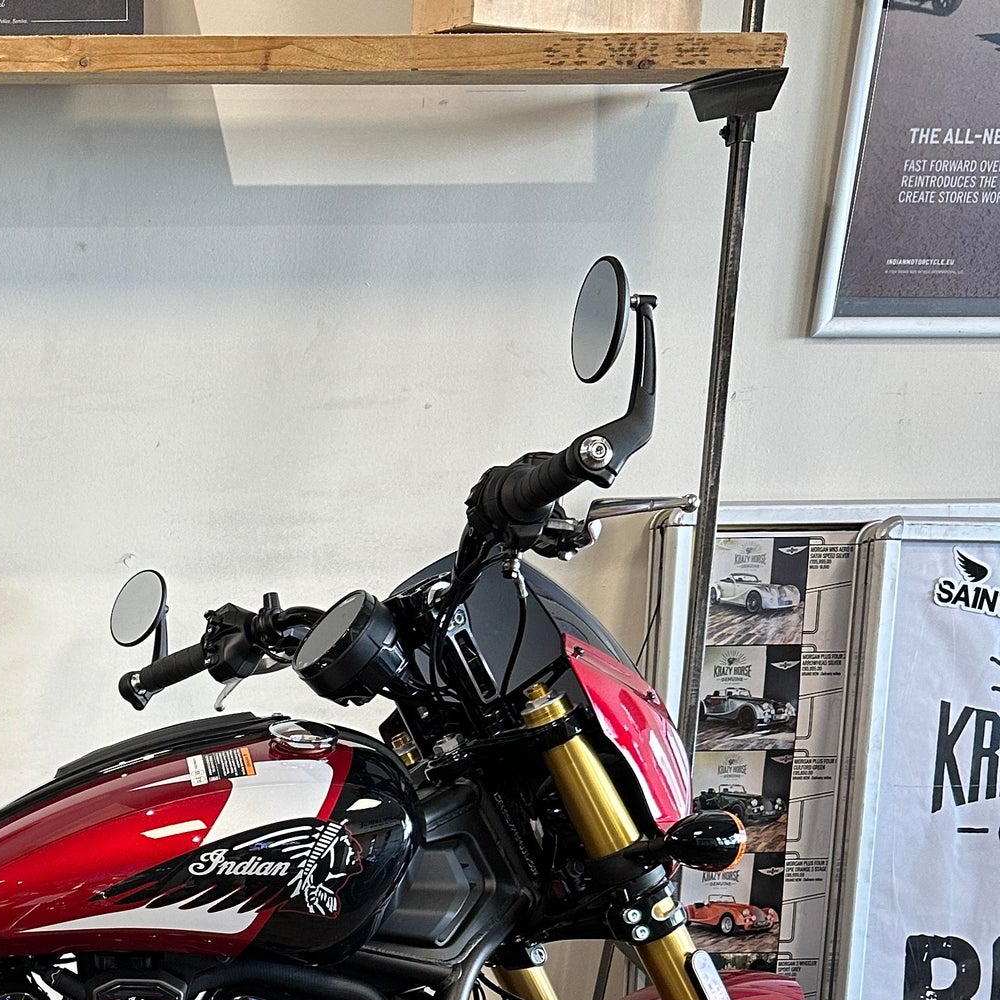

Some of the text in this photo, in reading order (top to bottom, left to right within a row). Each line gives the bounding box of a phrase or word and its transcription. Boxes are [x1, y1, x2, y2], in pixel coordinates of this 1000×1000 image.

[910, 128, 941, 145] THE
[903, 159, 1000, 173] FAST FORWARD OVE
[900, 175, 998, 188] REINTRODUCES THE
[898, 191, 936, 204] CREATE
[938, 191, 979, 204] STORIES
[713, 664, 752, 678] KRAZY HORSE
[188, 849, 291, 877] Indian
